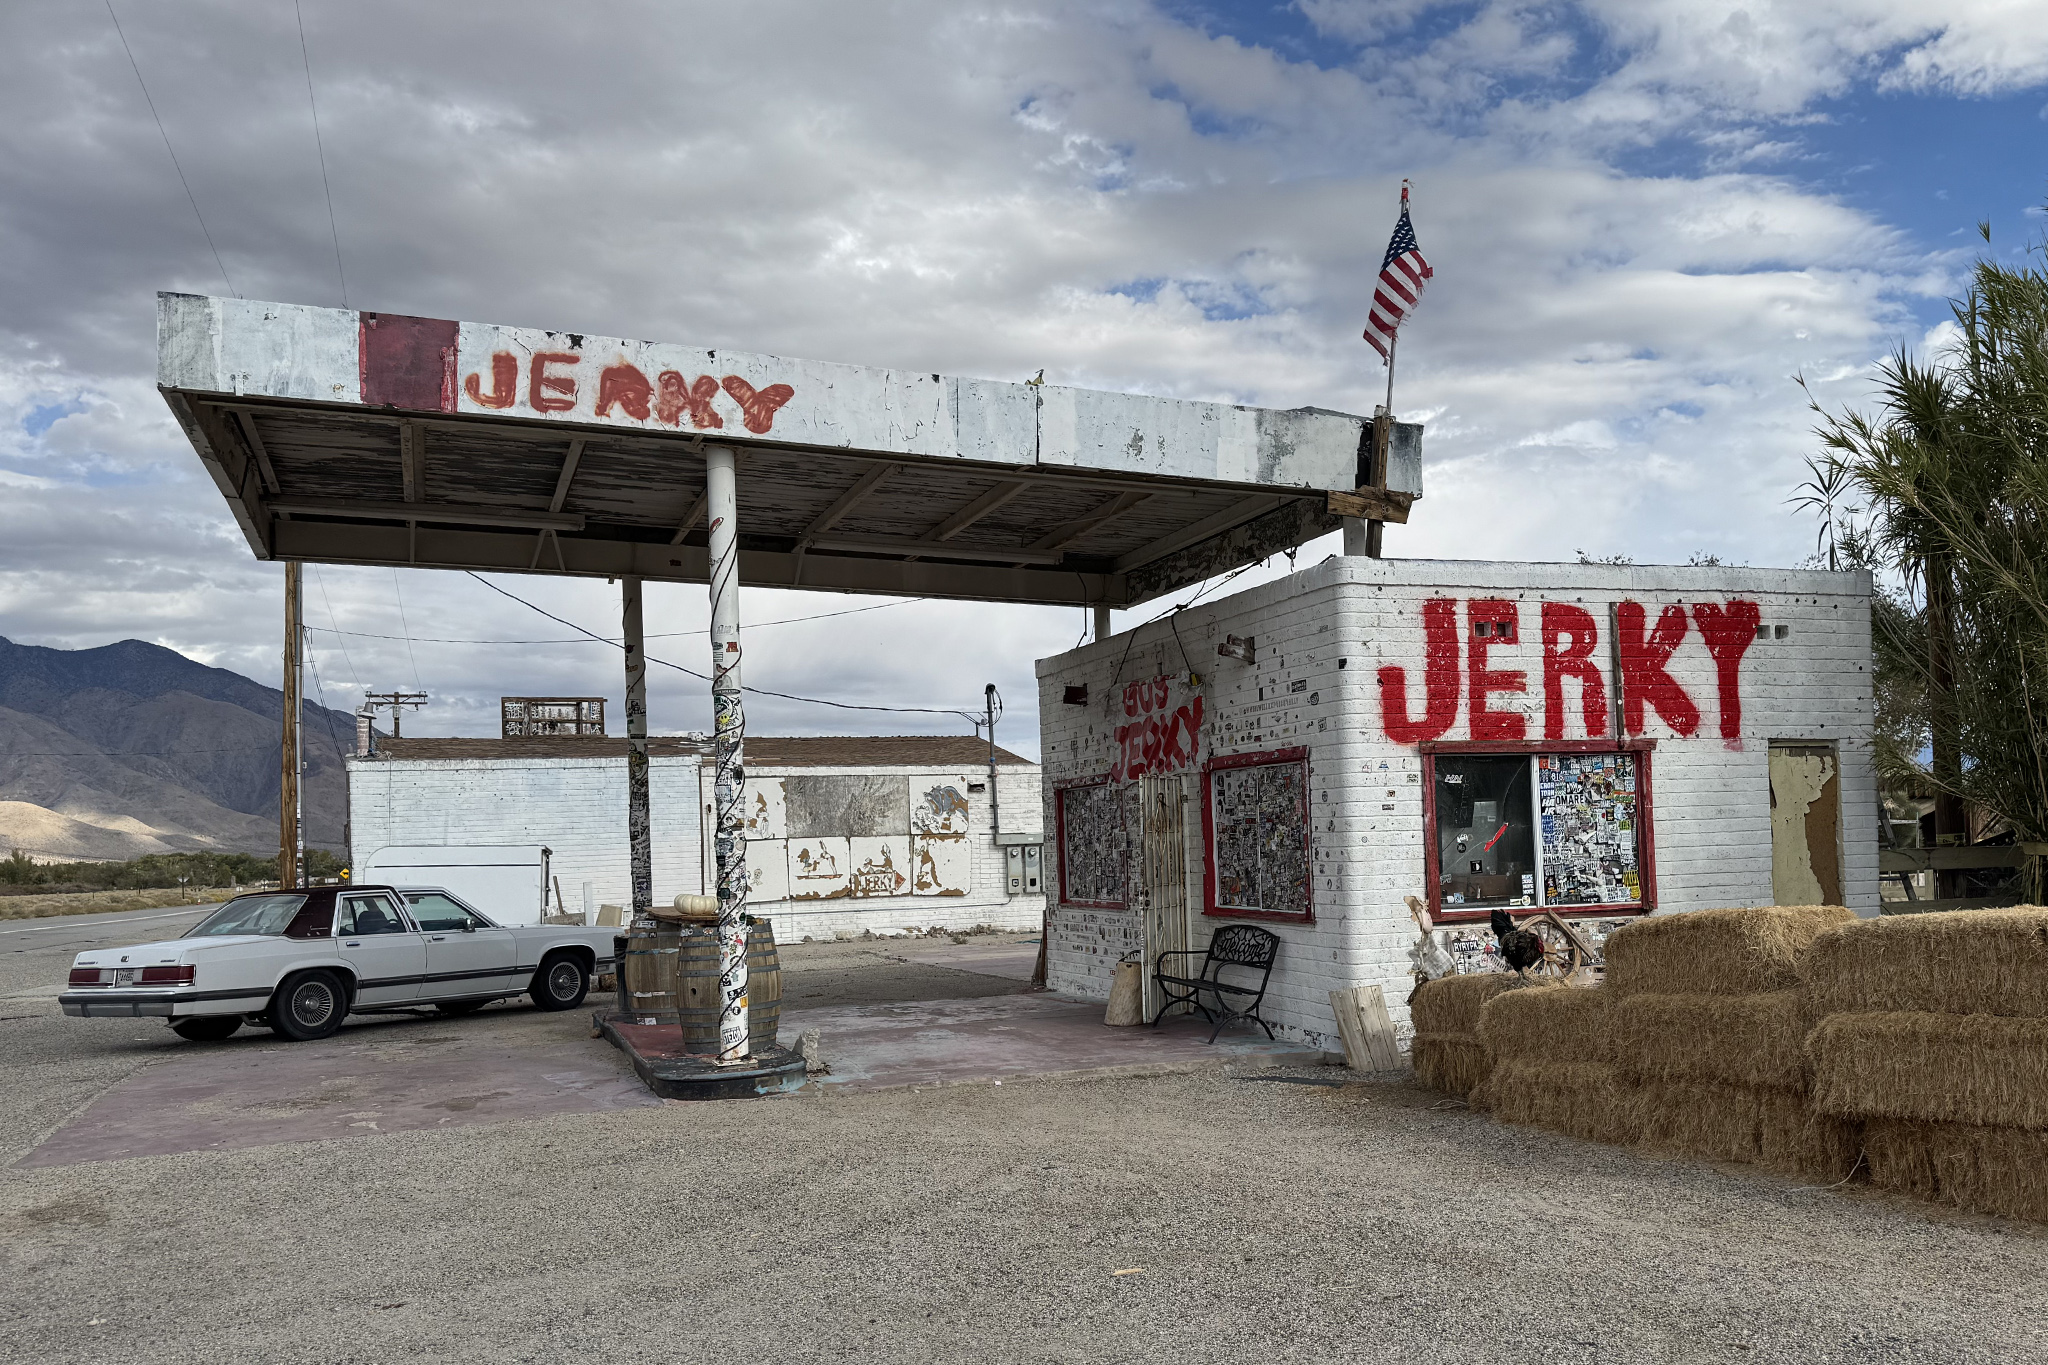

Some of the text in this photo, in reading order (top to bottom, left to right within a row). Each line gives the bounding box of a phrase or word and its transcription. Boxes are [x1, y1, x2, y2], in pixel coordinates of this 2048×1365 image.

[465, 351, 796, 435] JERKY
[1377, 597, 1762, 745] JERKY
[1111, 695, 1203, 783] JERKY
[863, 873, 895, 891] JERKY
